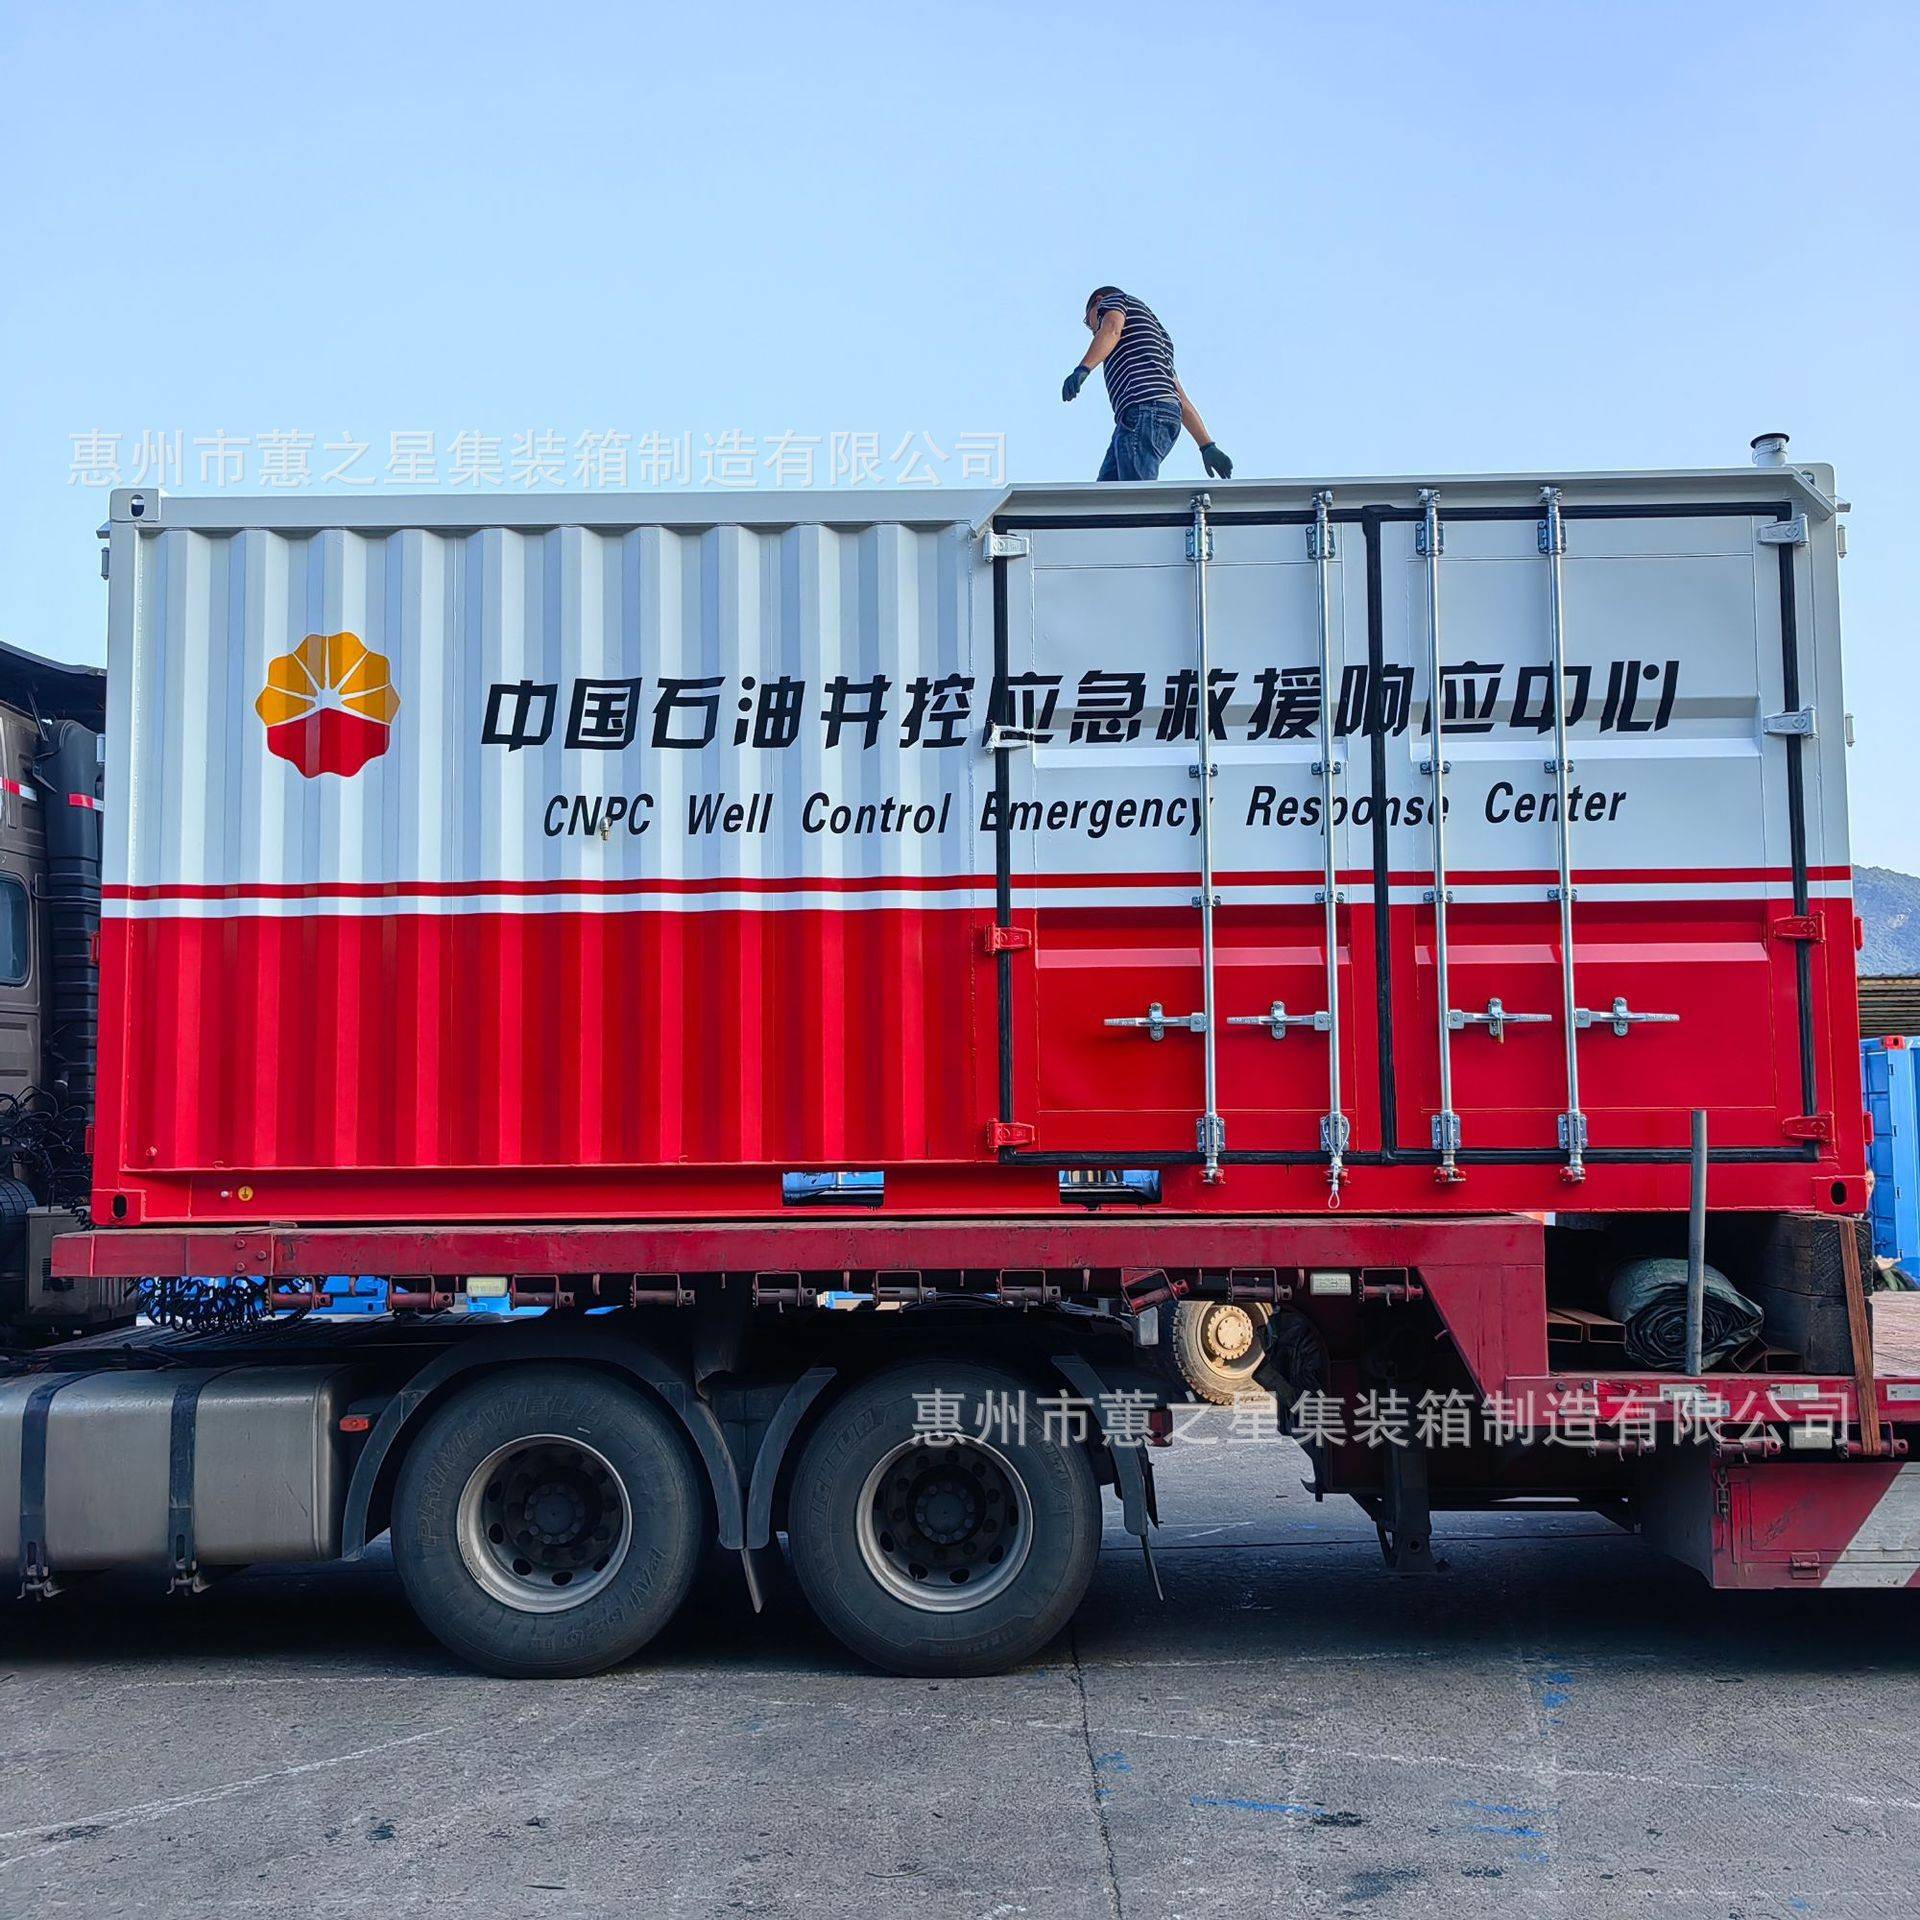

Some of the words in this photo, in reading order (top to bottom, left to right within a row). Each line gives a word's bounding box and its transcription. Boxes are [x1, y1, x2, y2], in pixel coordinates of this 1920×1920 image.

[481, 660, 1680, 751] 中国石油井控应急救援响应中心
[543, 793, 654, 837] CNPC
[688, 792, 774, 835] Well
[801, 792, 952, 835] Control
[980, 790, 1214, 839] Emergency
[1485, 781, 1627, 824] Center
